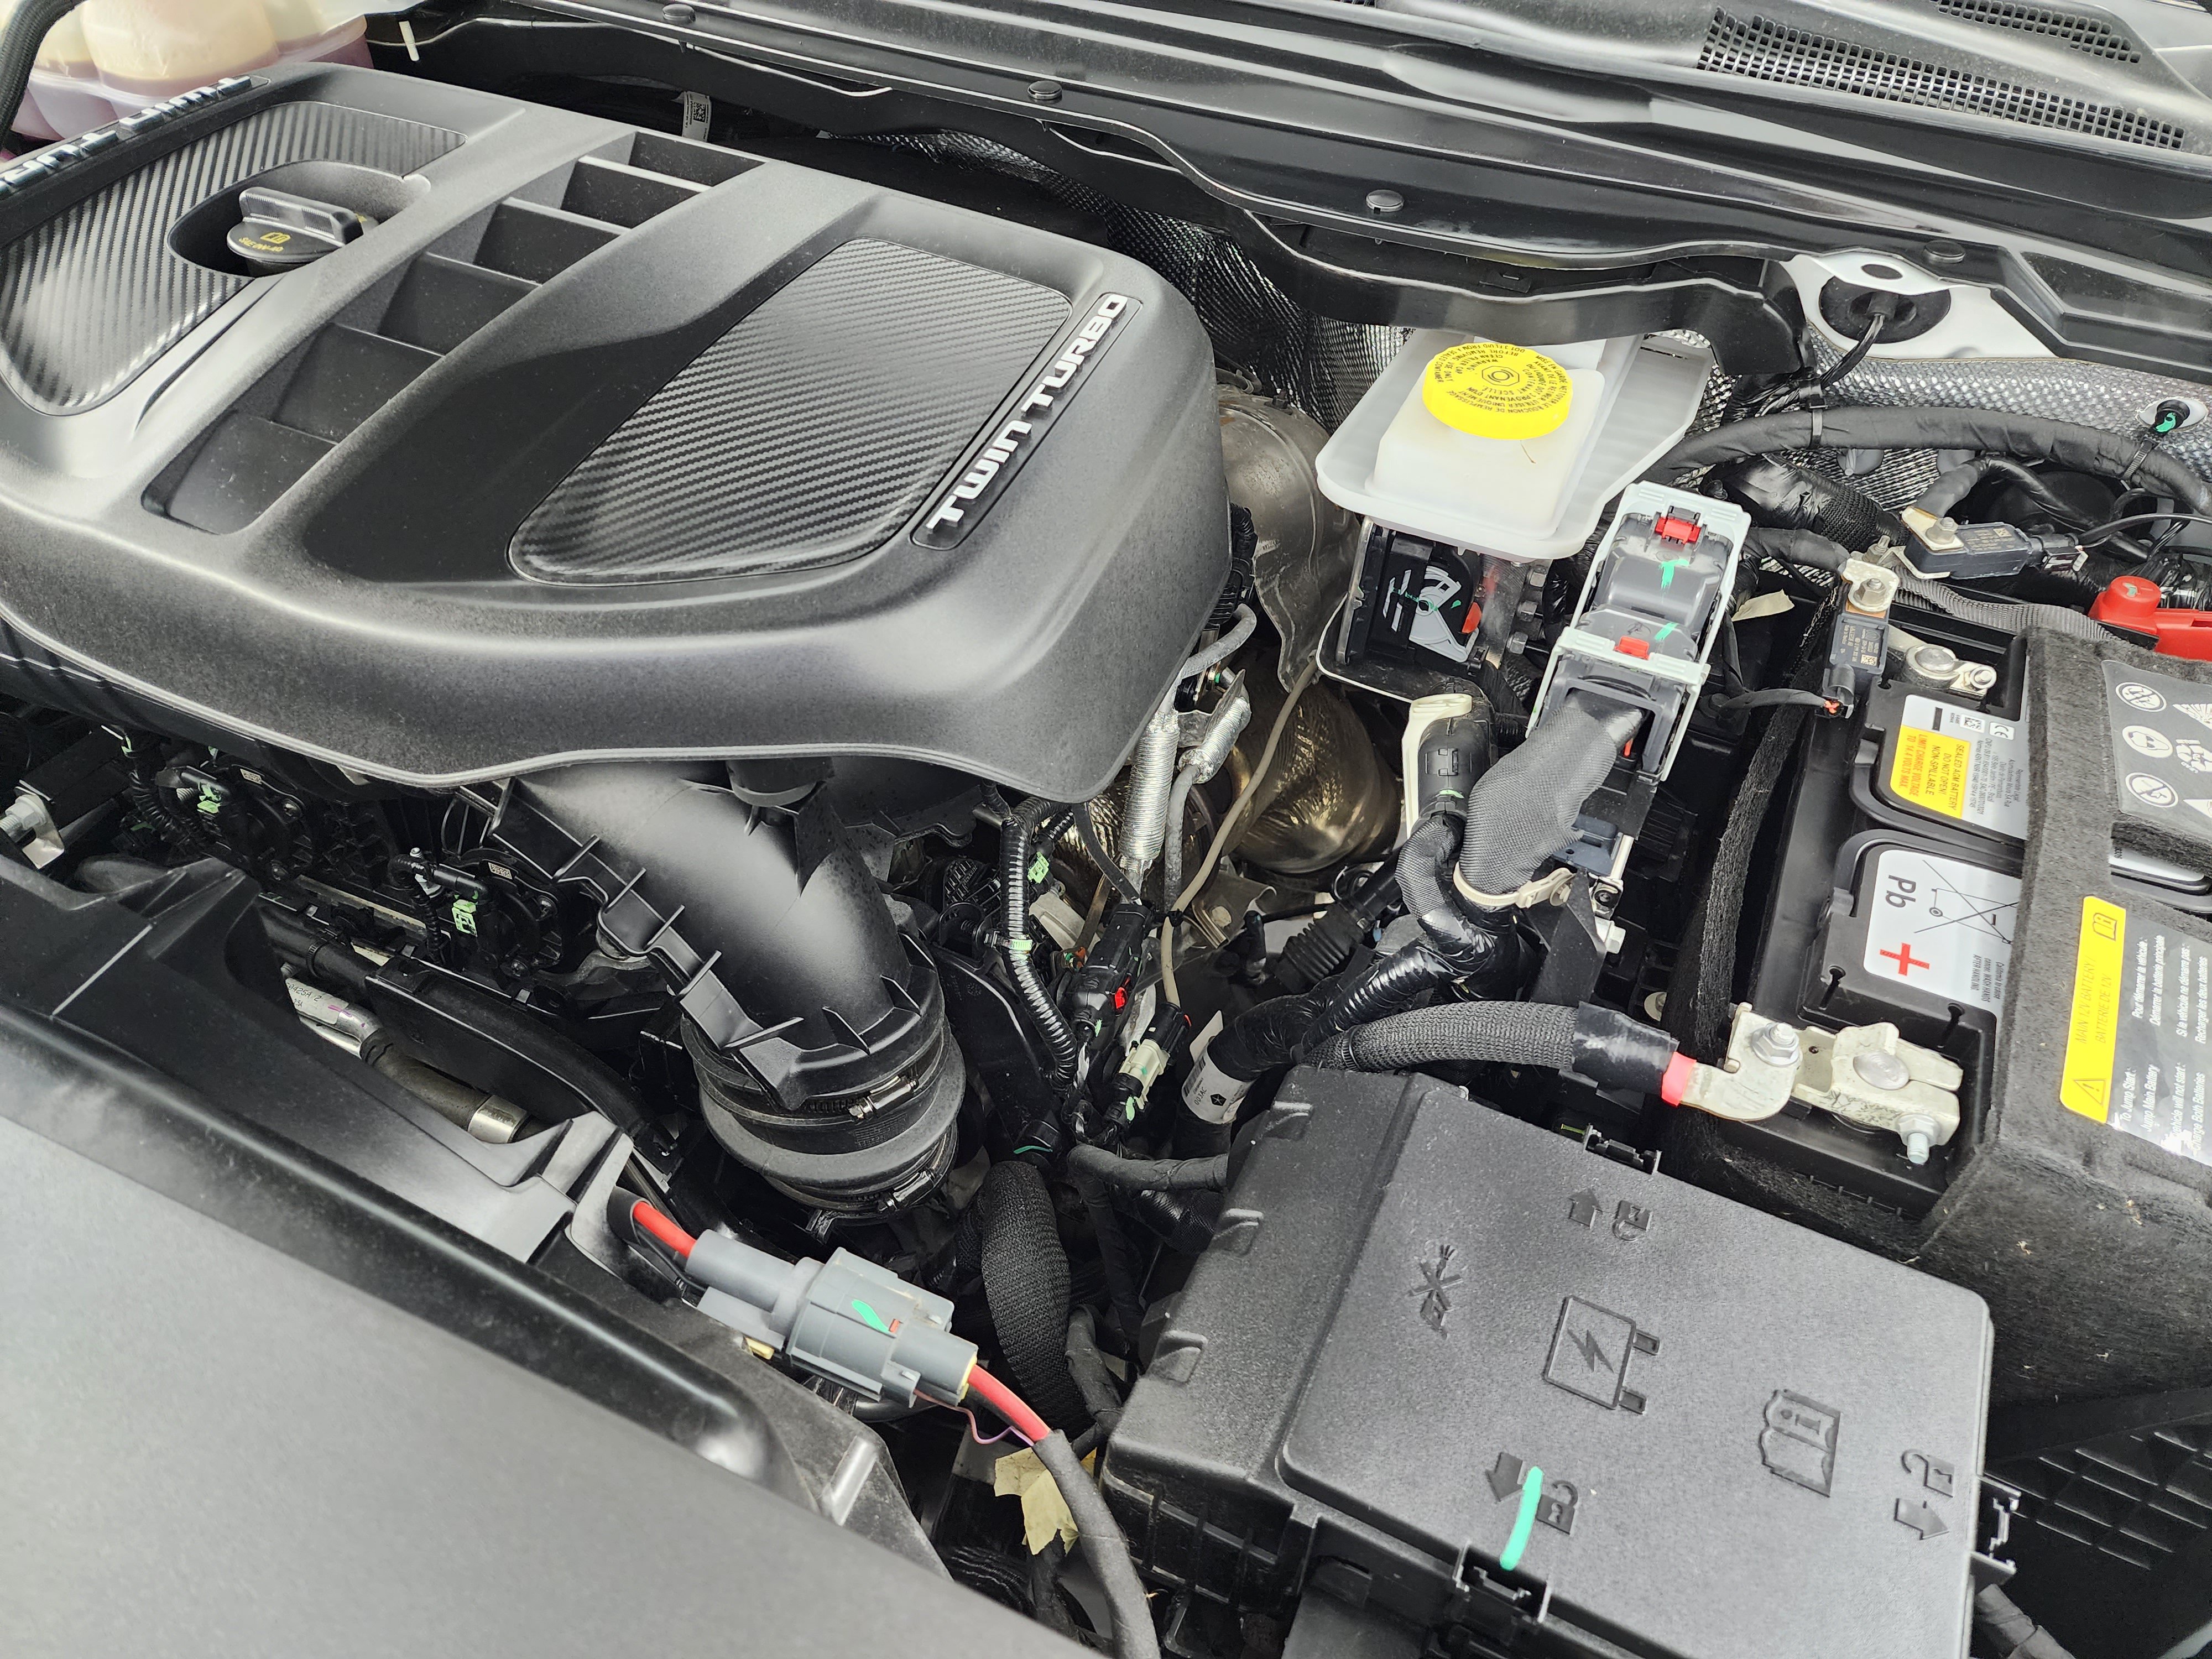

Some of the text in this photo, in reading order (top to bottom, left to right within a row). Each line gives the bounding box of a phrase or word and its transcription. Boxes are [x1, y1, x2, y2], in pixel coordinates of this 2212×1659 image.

[118, 75, 252, 131] TWIN
[1439, 351, 1457, 362] SEALED
[1533, 361, 1552, 373] AVANT
[1535, 355, 1551, 364] MISE
[1444, 370, 1454, 382] ONLY
[1517, 369, 1536, 394] CONTENANT
[1447, 390, 1493, 411] REMPLISSAGE
[1459, 390, 1505, 407] UNIQUEMENT
[1551, 386, 1568, 404] NETTOYER
[926, 294, 1128, 530] TWIN TURBO
[1905, 745, 1914, 757] 14.4
[1943, 753, 1952, 762] DO
[1954, 744, 1964, 768] SEALED
[1902, 758, 1912, 774] VOLTS
[1910, 734, 1927, 796] LIMIT CHARGE VOLTAGE
[1926, 745, 1940, 795] NON-SPILLABLE
[1949, 783, 1959, 810] BATTERY
[1885, 875, 1916, 908] Pb
[2153, 935, 2166, 965] principale
[1973, 954, 1981, 968] AFTER
[1983, 974, 1991, 987] WASH
[1995, 962, 2004, 982] California
[2081, 963, 2094, 1001] BATTERY
[2152, 964, 2163, 988] batterie
[2178, 960, 2189, 985] démarre
[1982, 987, 1990, 1002] HANDS
[2133, 973, 2146, 1003] démarrer
[2180, 985, 2189, 995] ne
[2079, 1004, 2090, 1017] 12V
[2095, 977, 2111, 1044] BATTERIE DE 12V
[2132, 1002, 2143, 1018] Pour
[2150, 994, 2162, 1026] Démarrer
[2177, 995, 2188, 1021] véhicule
[2195, 956, 2209, 1044] Recharger les deux batteries
[2075, 1021, 2088, 1044] MAIN
[2176, 1028, 2188, 1037] Si
[2141, 1065, 2160, 1132] Jump Main Battery
[2174, 1083, 2185, 1097] not
[2193, 1072, 2205, 1104] Batteries
[2121, 1091, 2136, 1112] Jump
[2172, 1095, 2184, 1109] will
[2120, 1113, 2132, 1121] To
[2192, 1105, 2203, 1123] Both
